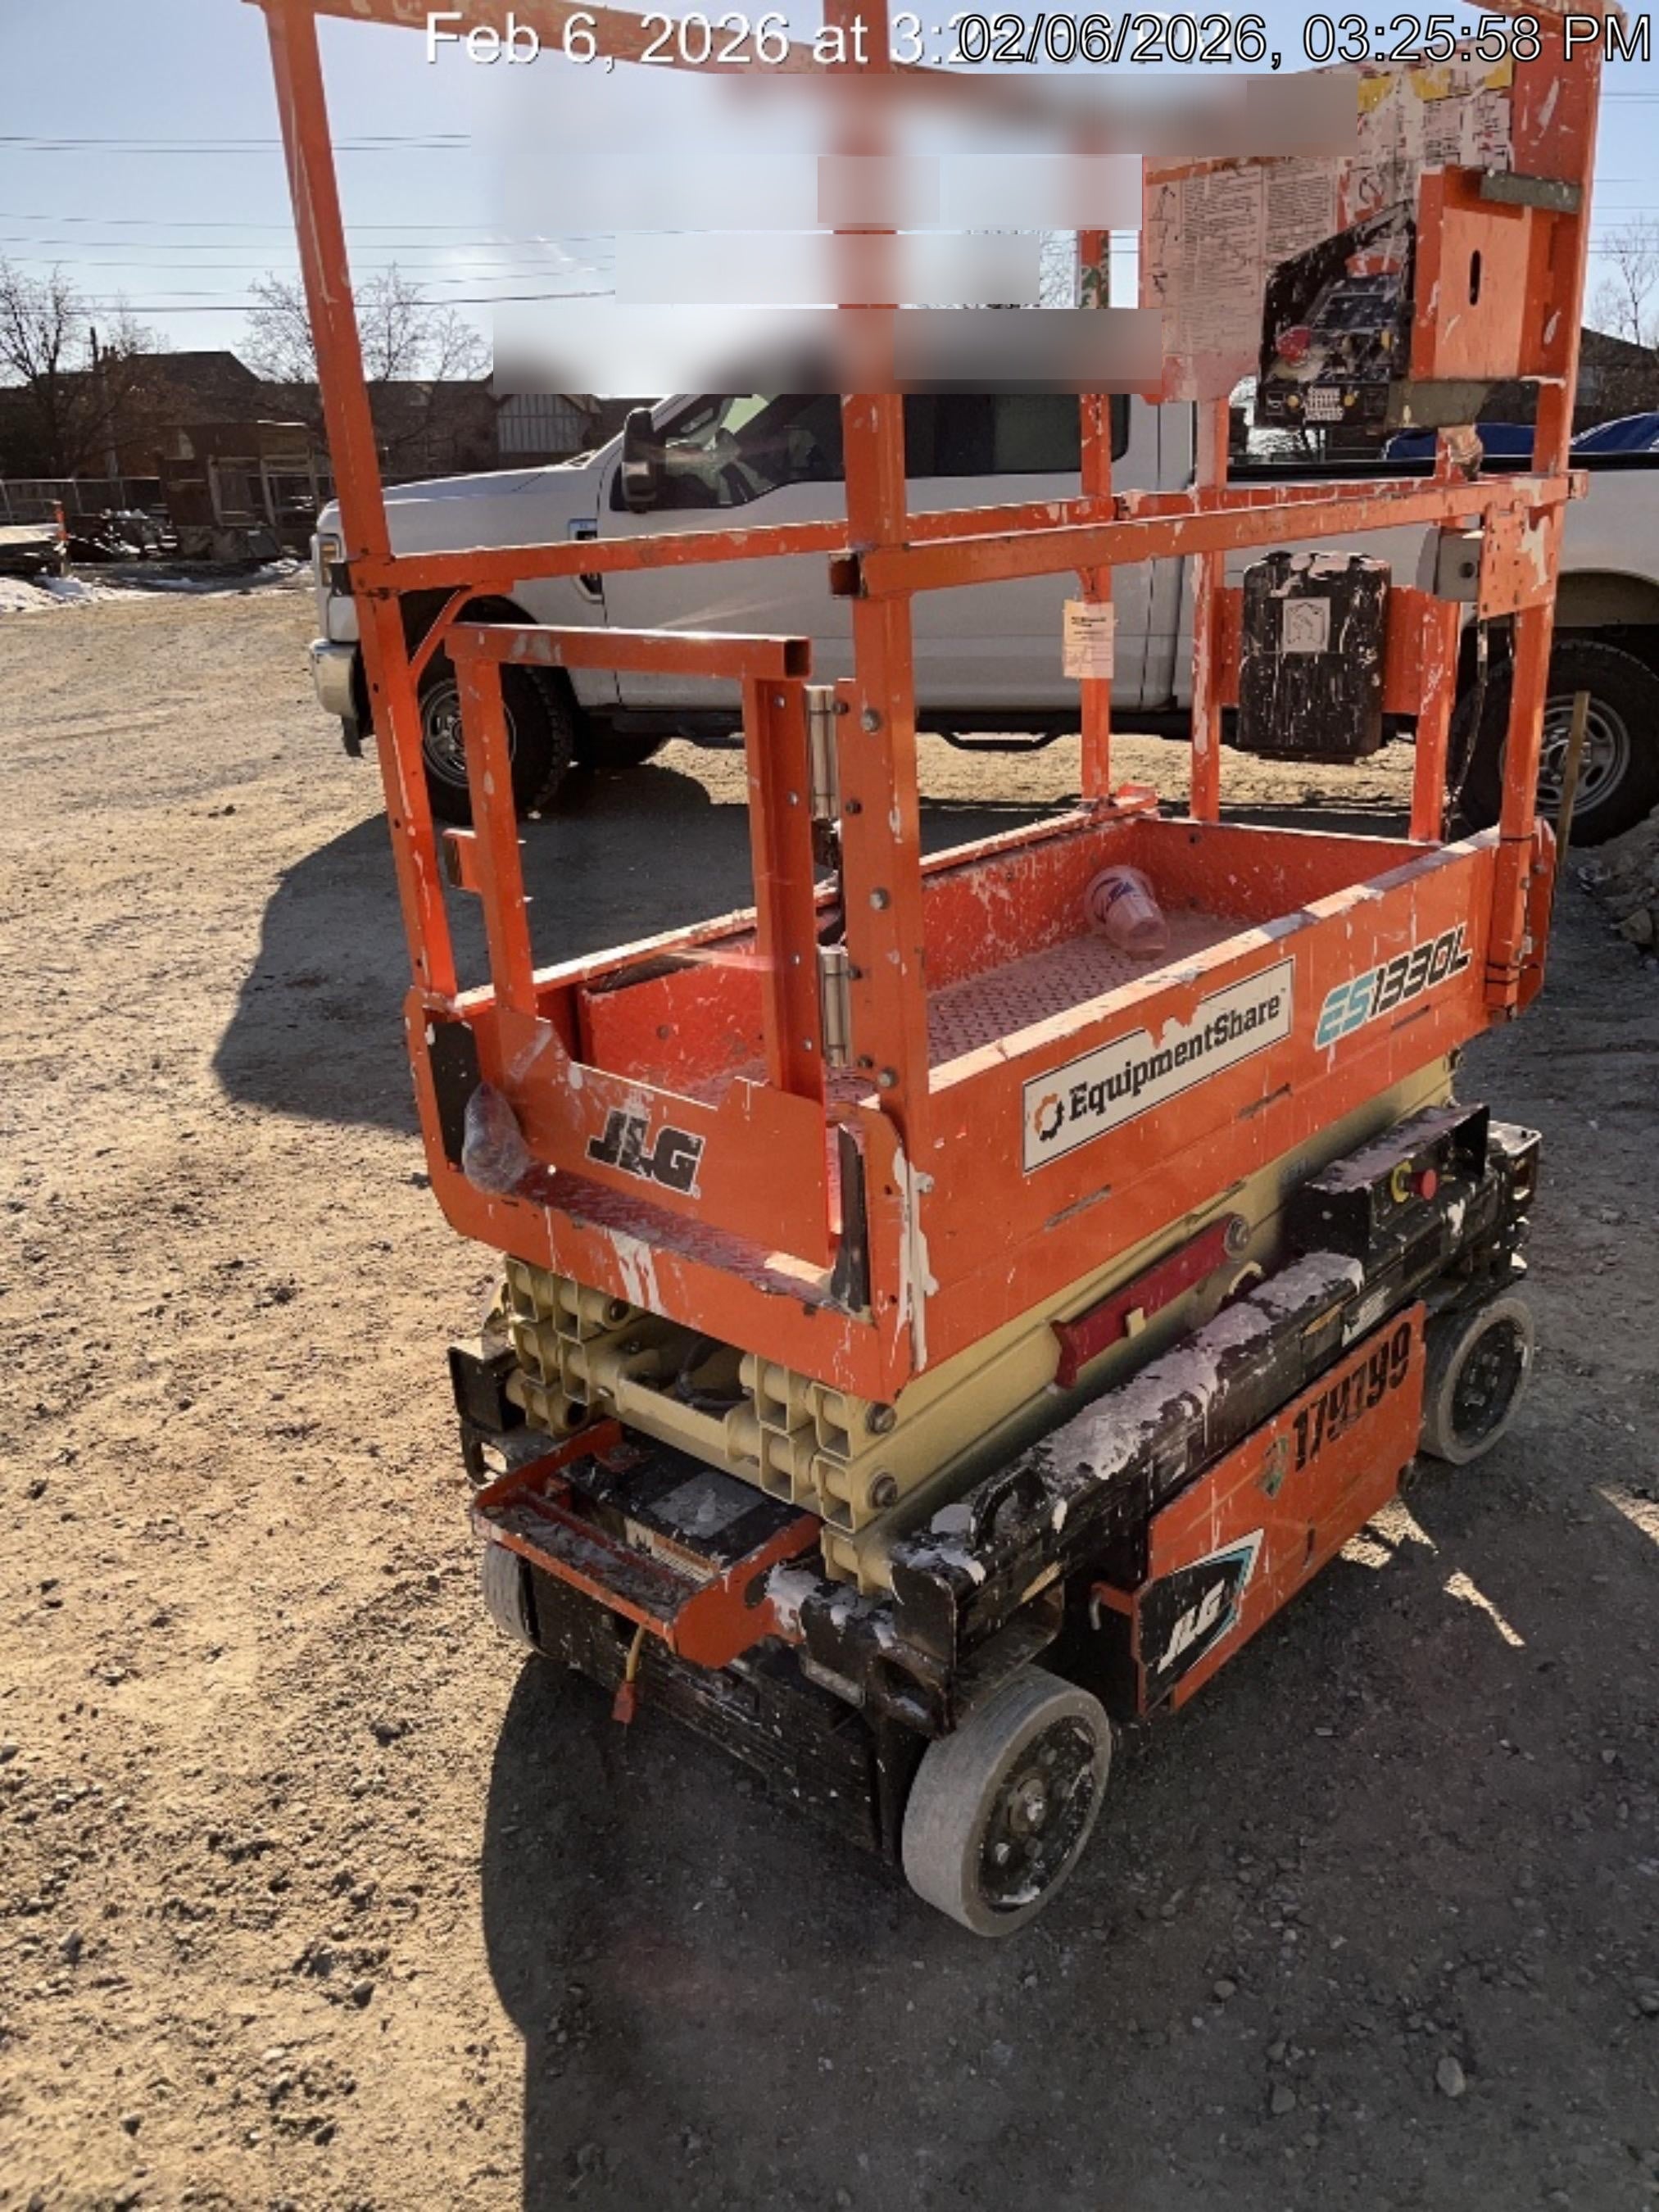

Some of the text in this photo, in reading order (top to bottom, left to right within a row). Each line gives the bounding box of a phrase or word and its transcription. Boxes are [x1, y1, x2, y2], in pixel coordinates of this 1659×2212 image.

[1316, 924, 1471, 1048] ES1330L
[1068, 994, 1281, 1122] EquipmentShare
[586, 1109, 705, 1196] JLG
[1156, 1577, 1226, 1675] JLG
